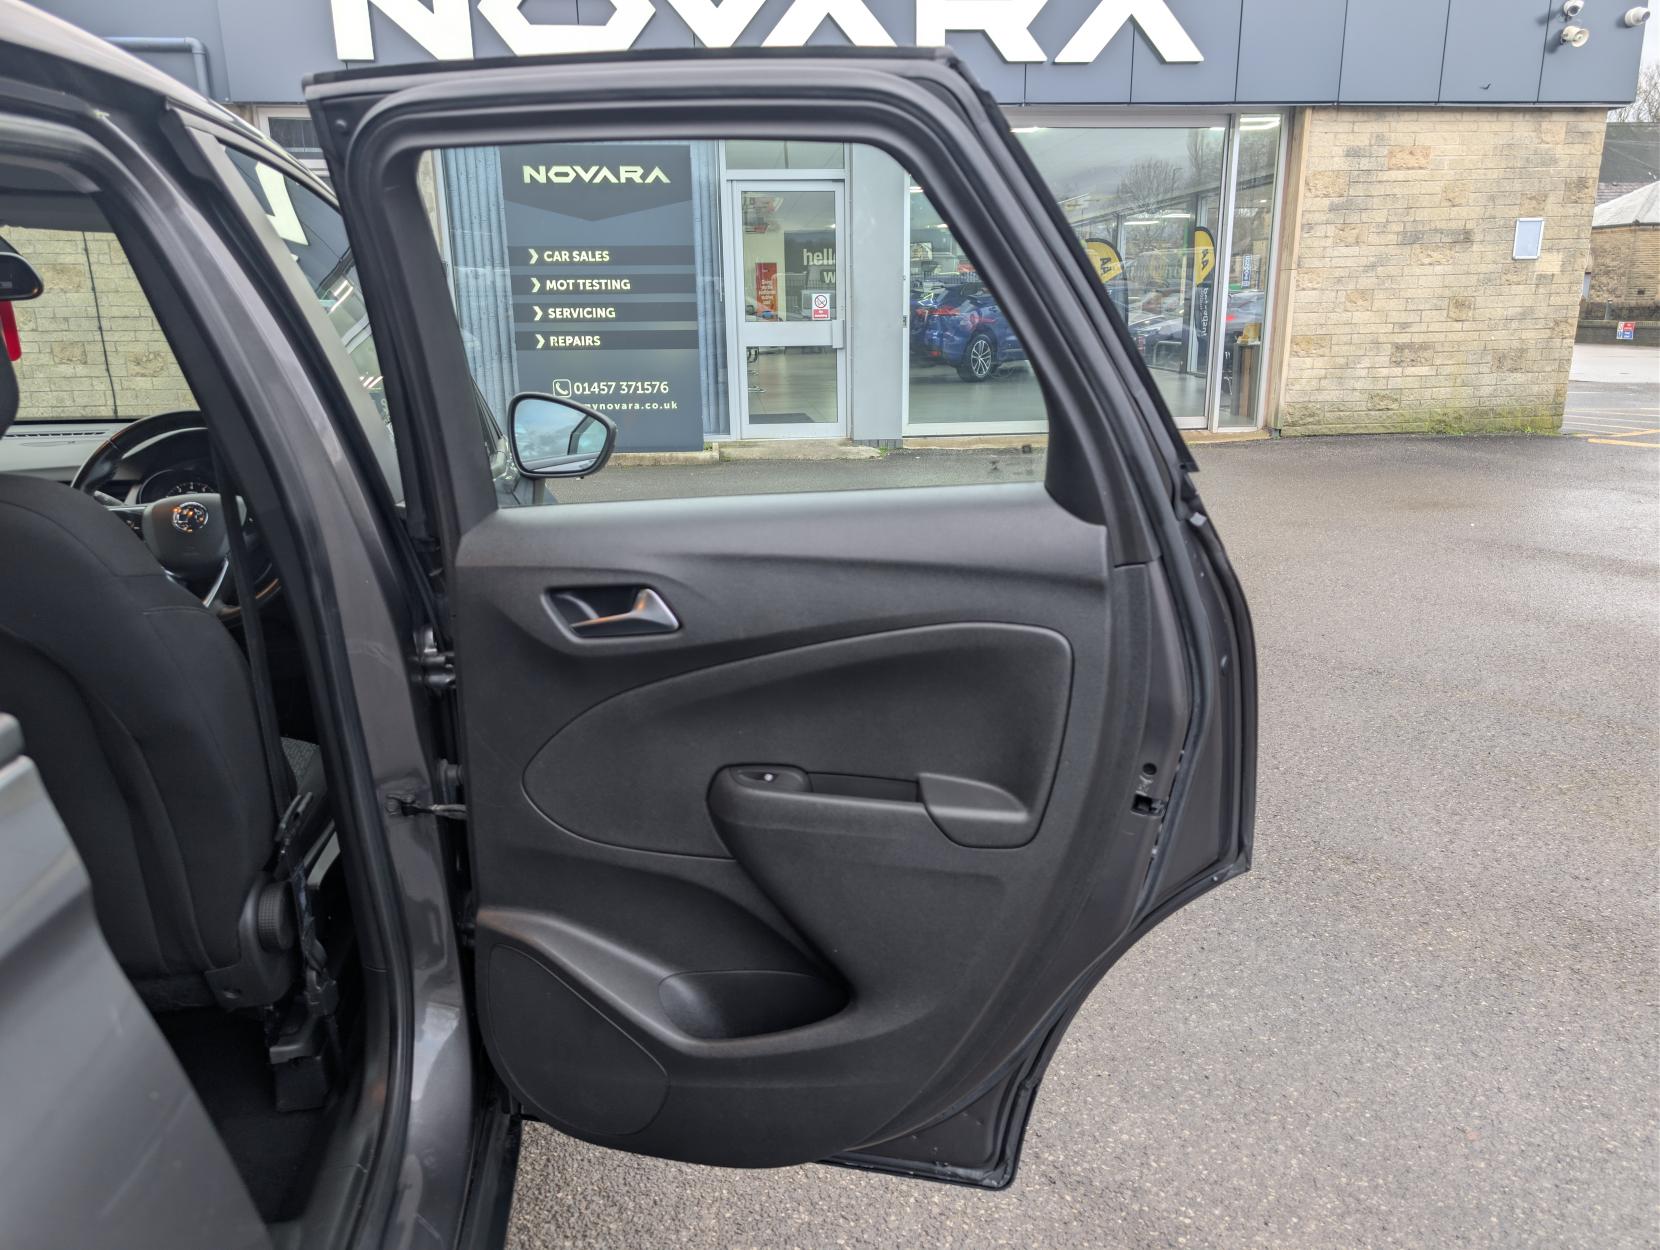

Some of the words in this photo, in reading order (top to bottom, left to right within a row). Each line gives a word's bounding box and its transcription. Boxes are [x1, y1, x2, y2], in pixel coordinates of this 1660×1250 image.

[522, 165, 671, 184] NOVARA
[543, 250, 570, 262] CAR
[572, 250, 610, 262] SALES
[803, 248, 836, 265] hell
[546, 279, 575, 291] MOT
[577, 279, 631, 291] TESTING
[547, 307, 616, 319] SERVICING
[549, 335, 601, 347] REPAIRS
[573, 382, 616, 395] 01457
[619, 381, 669, 394] 371576
